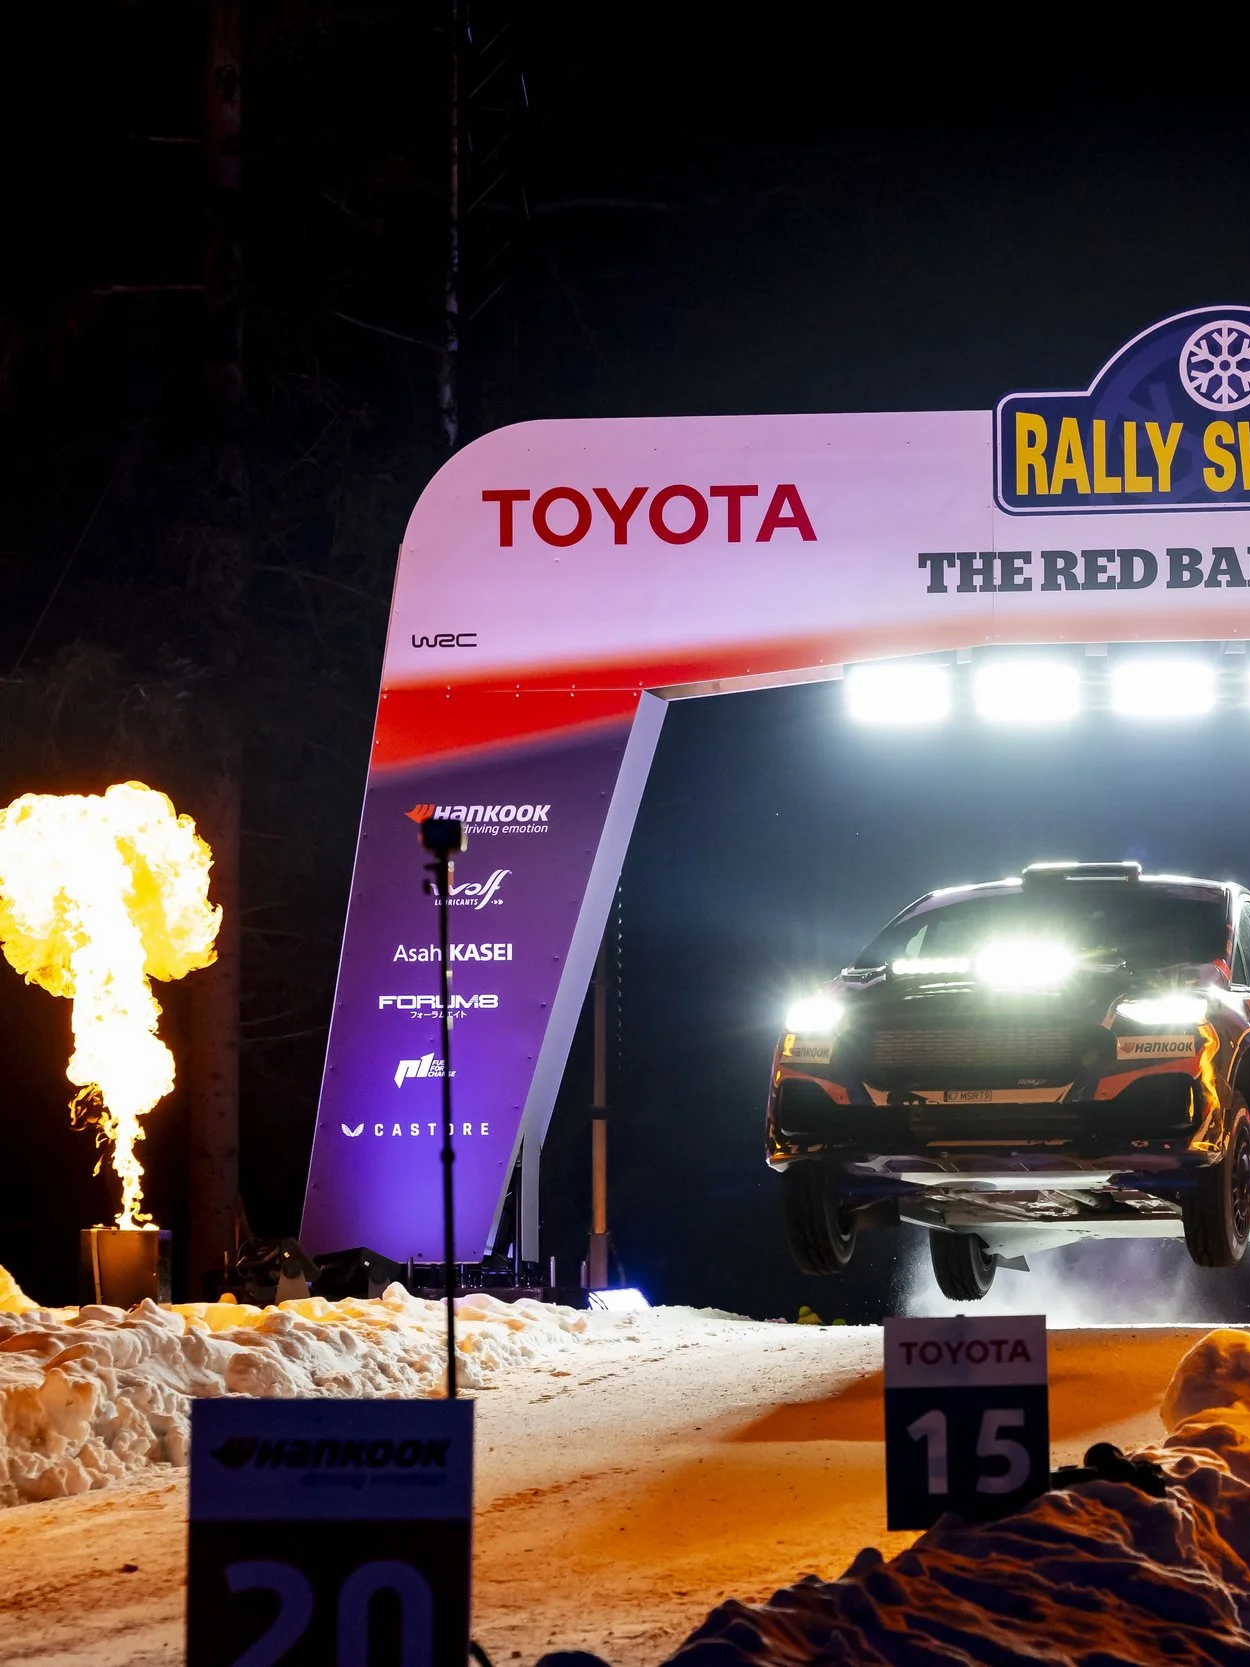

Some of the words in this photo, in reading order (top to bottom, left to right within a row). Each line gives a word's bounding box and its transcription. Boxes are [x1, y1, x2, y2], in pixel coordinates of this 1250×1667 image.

[1015, 411, 1184, 496] RALLY
[481, 484, 818, 548] TOYOTA
[918, 550, 1033, 594] THE
[1040, 548, 1159, 592] RED
[411, 633, 478, 648] WRC
[502, 823, 549, 834] emotion
[434, 898, 479, 906] LURICANTS
[378, 994, 499, 1010] FORUM8
[898, 1338, 1032, 1366] TOYOTA
[906, 1408, 1031, 1495] 15
[224, 1560, 435, 1667] 20
